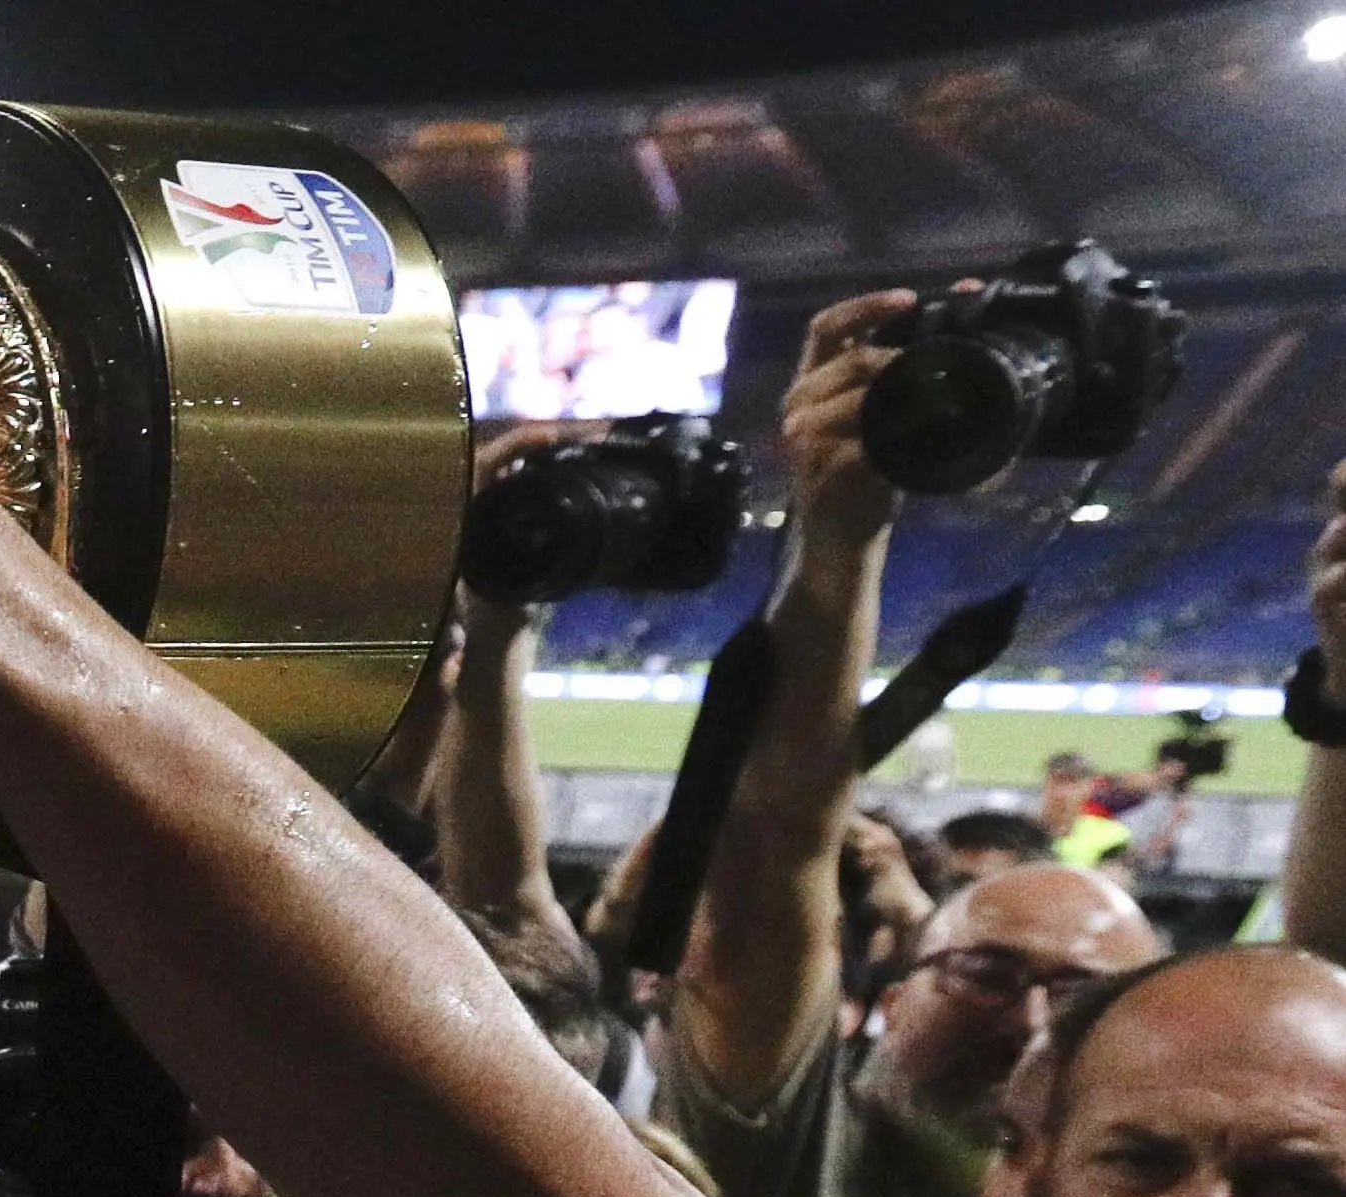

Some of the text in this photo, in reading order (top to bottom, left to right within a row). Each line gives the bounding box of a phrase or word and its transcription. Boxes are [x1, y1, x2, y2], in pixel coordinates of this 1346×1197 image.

[268, 181, 314, 231] CUP
[313, 189, 370, 247] TIM
[298, 236, 338, 292] TIM
